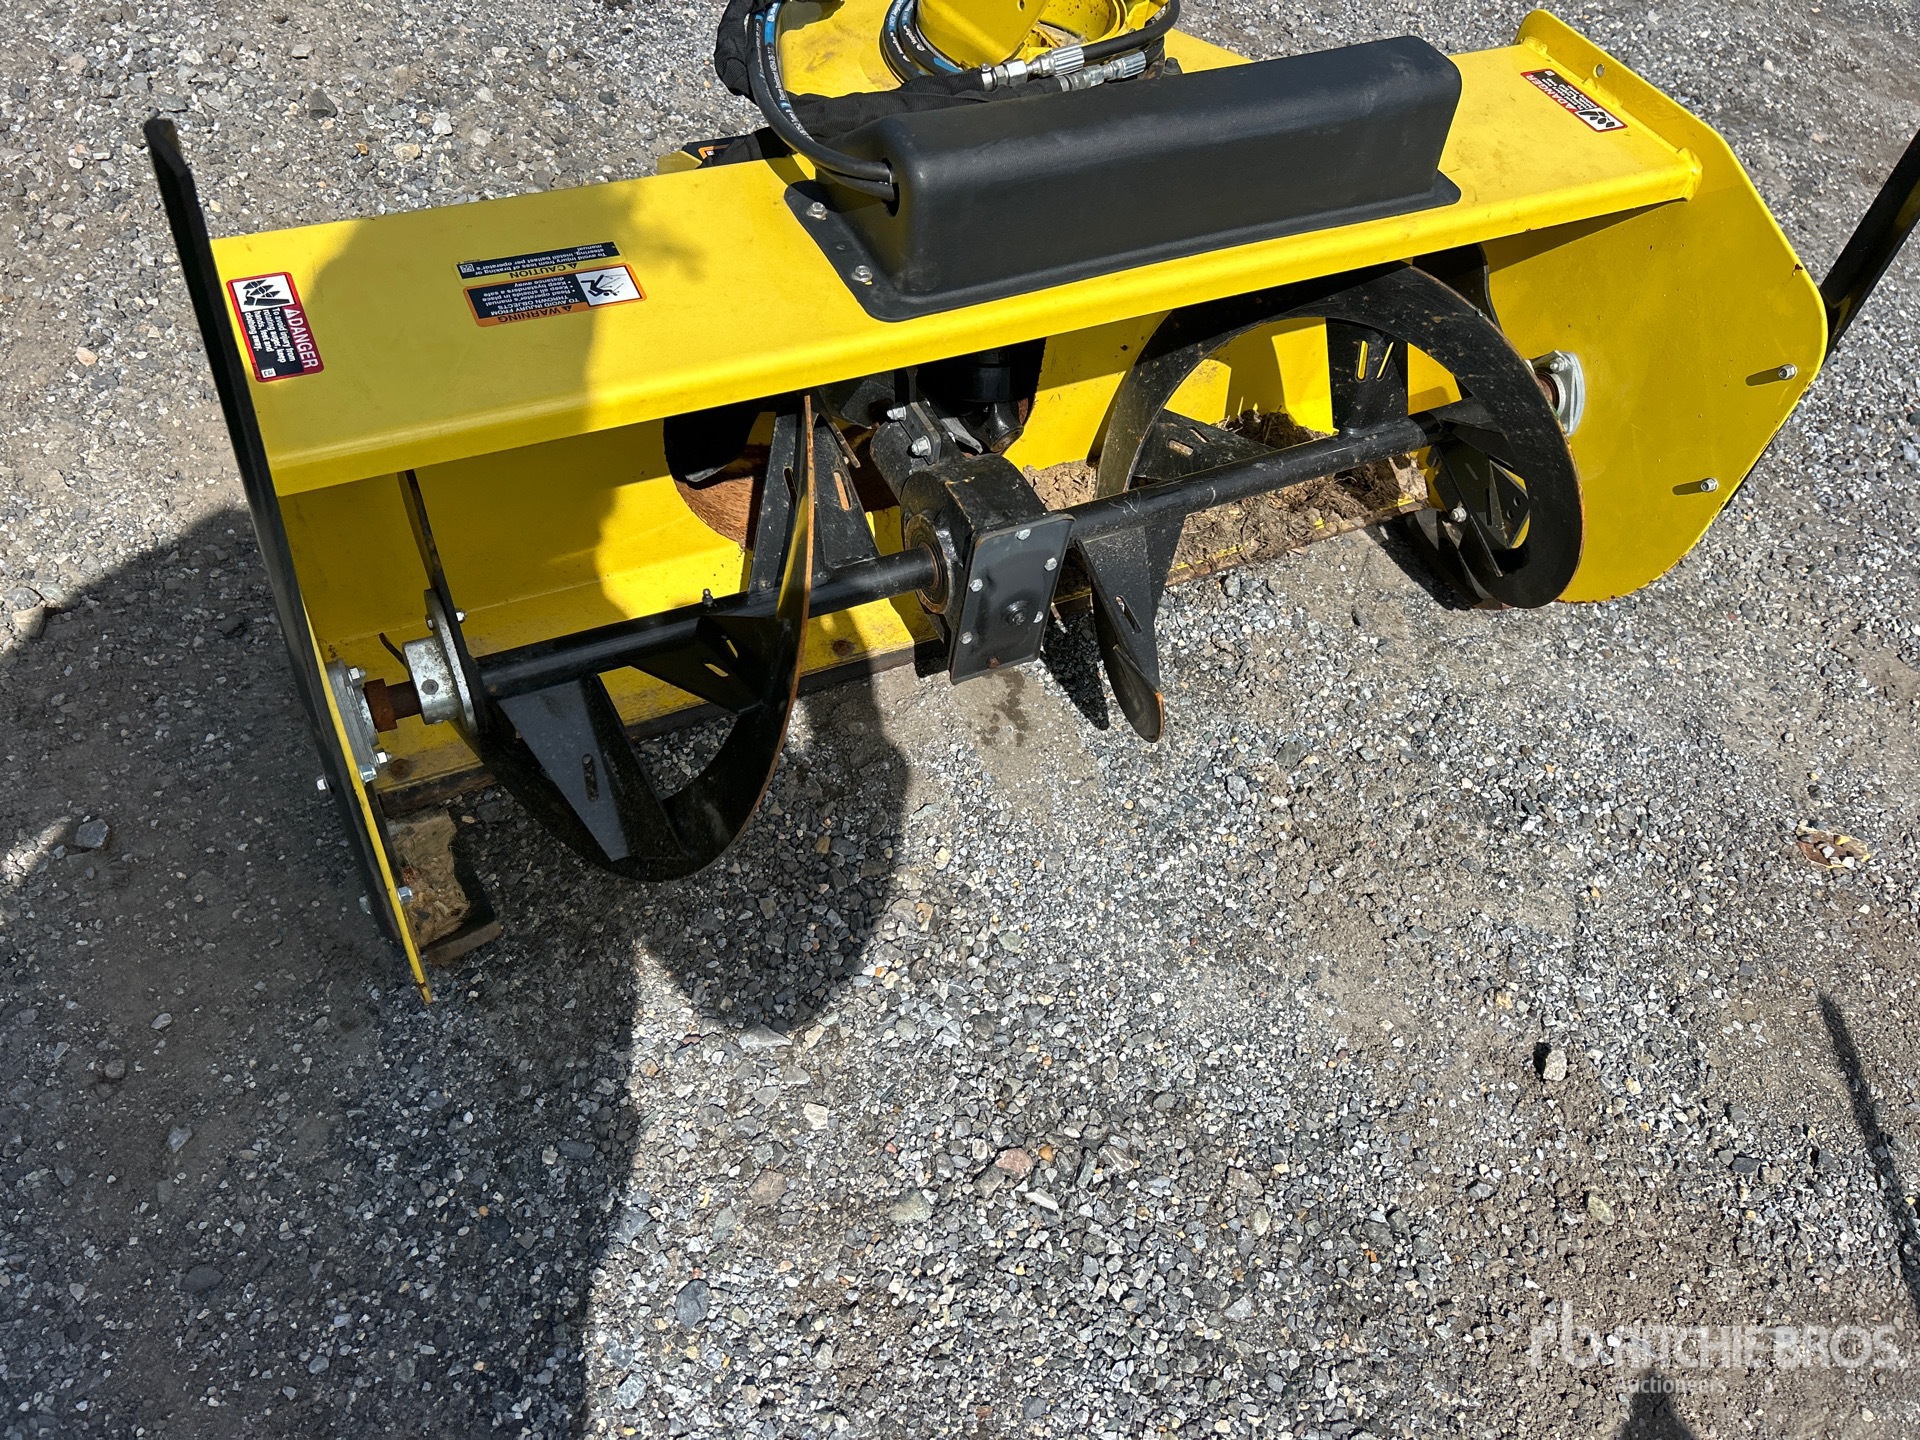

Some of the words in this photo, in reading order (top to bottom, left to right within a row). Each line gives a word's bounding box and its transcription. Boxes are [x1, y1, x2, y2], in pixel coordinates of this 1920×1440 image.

[1524, 74, 1569, 104] DANGER
[574, 247, 604, 255] steering,
[483, 266, 511, 274] braking
[508, 264, 567, 278] CAUTION
[533, 276, 564, 284] distance
[506, 283, 546, 293] bystanders
[511, 289, 538, 297] shields
[481, 294, 502, 302] place
[484, 298, 512, 306] manual
[513, 291, 550, 301] operator's
[534, 294, 568, 303] THROWN
[497, 300, 533, 309] OBJECTS
[514, 303, 542, 311] INJURY
[271, 307, 281, 315] To
[497, 306, 560, 323] WARNING
[243, 311, 258, 334] clothing
[253, 310, 266, 329] hands,
[261, 308, 276, 330] rotating
[274, 315, 286, 331] avoid
[260, 329, 270, 340] feet
[267, 330, 281, 348] auger,
[278, 330, 292, 347] injury
[250, 334, 262, 351] away.
[263, 340, 274, 352] and
[287, 317, 319, 368] DANGER
[274, 348, 287, 363] keep
[285, 347, 297, 361] from
